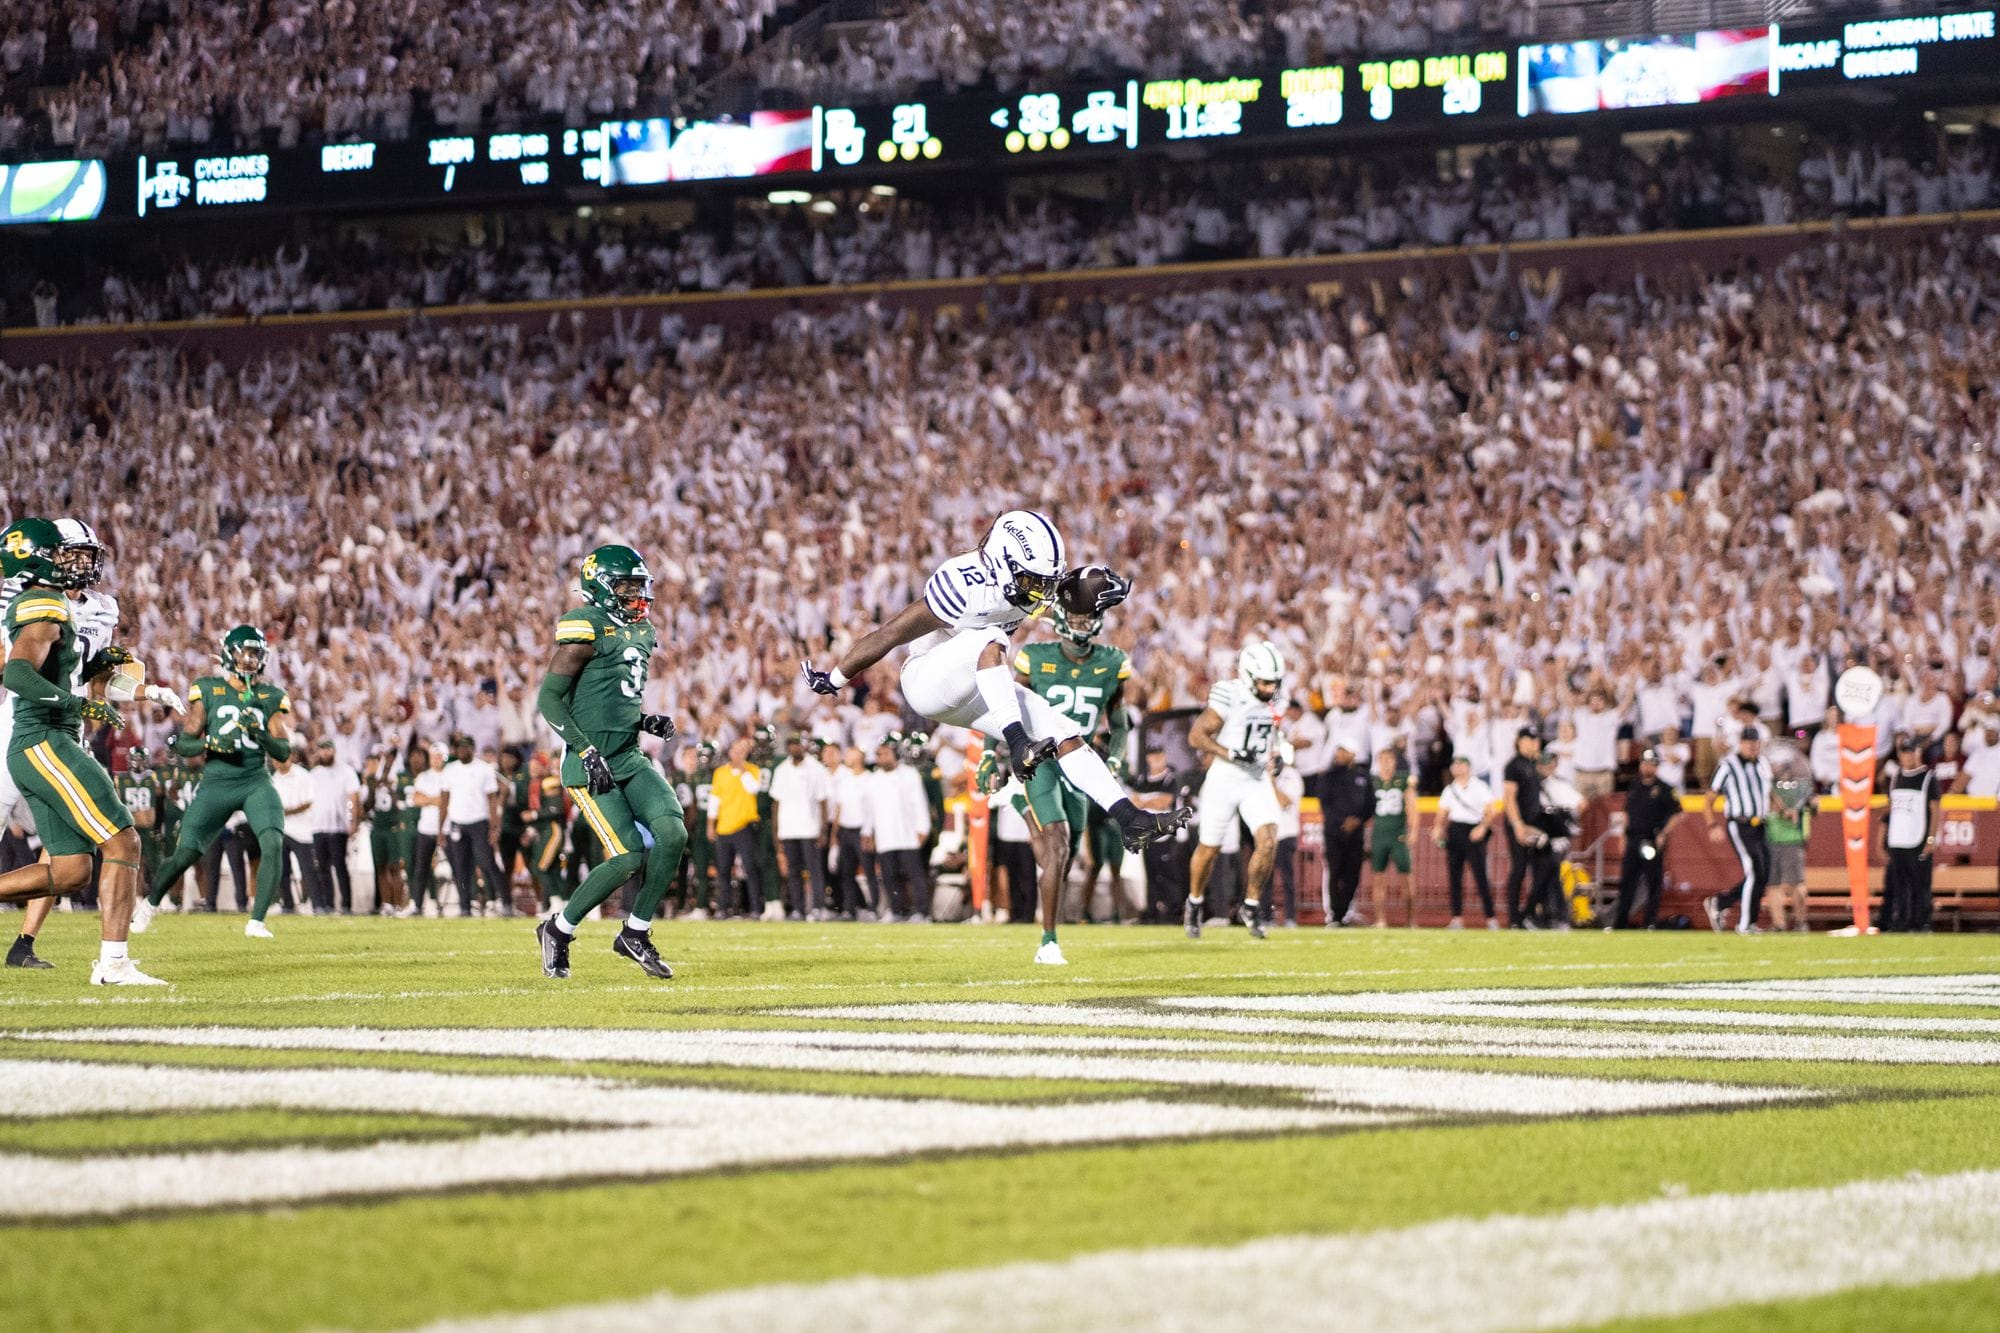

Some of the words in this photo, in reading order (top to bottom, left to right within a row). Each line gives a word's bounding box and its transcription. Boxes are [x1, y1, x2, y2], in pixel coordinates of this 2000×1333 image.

[1940, 11, 1995, 41] STATE
[1389, 59, 1420, 89] GO
[1475, 51, 1507, 82] ON
[1443, 75, 1481, 115] 20
[892, 103, 929, 144] 21
[1019, 93, 1060, 134] 33
[195, 155, 269, 180] CYCLONES
[6, 530, 32, 559] BU
[1003, 520, 1036, 561] Cyclones
[957, 565, 985, 587] 12
[620, 646, 644, 698] 3
[1046, 684, 1103, 736] 25
[1242, 722, 1272, 754] 13
[1943, 820, 1975, 846] 30
